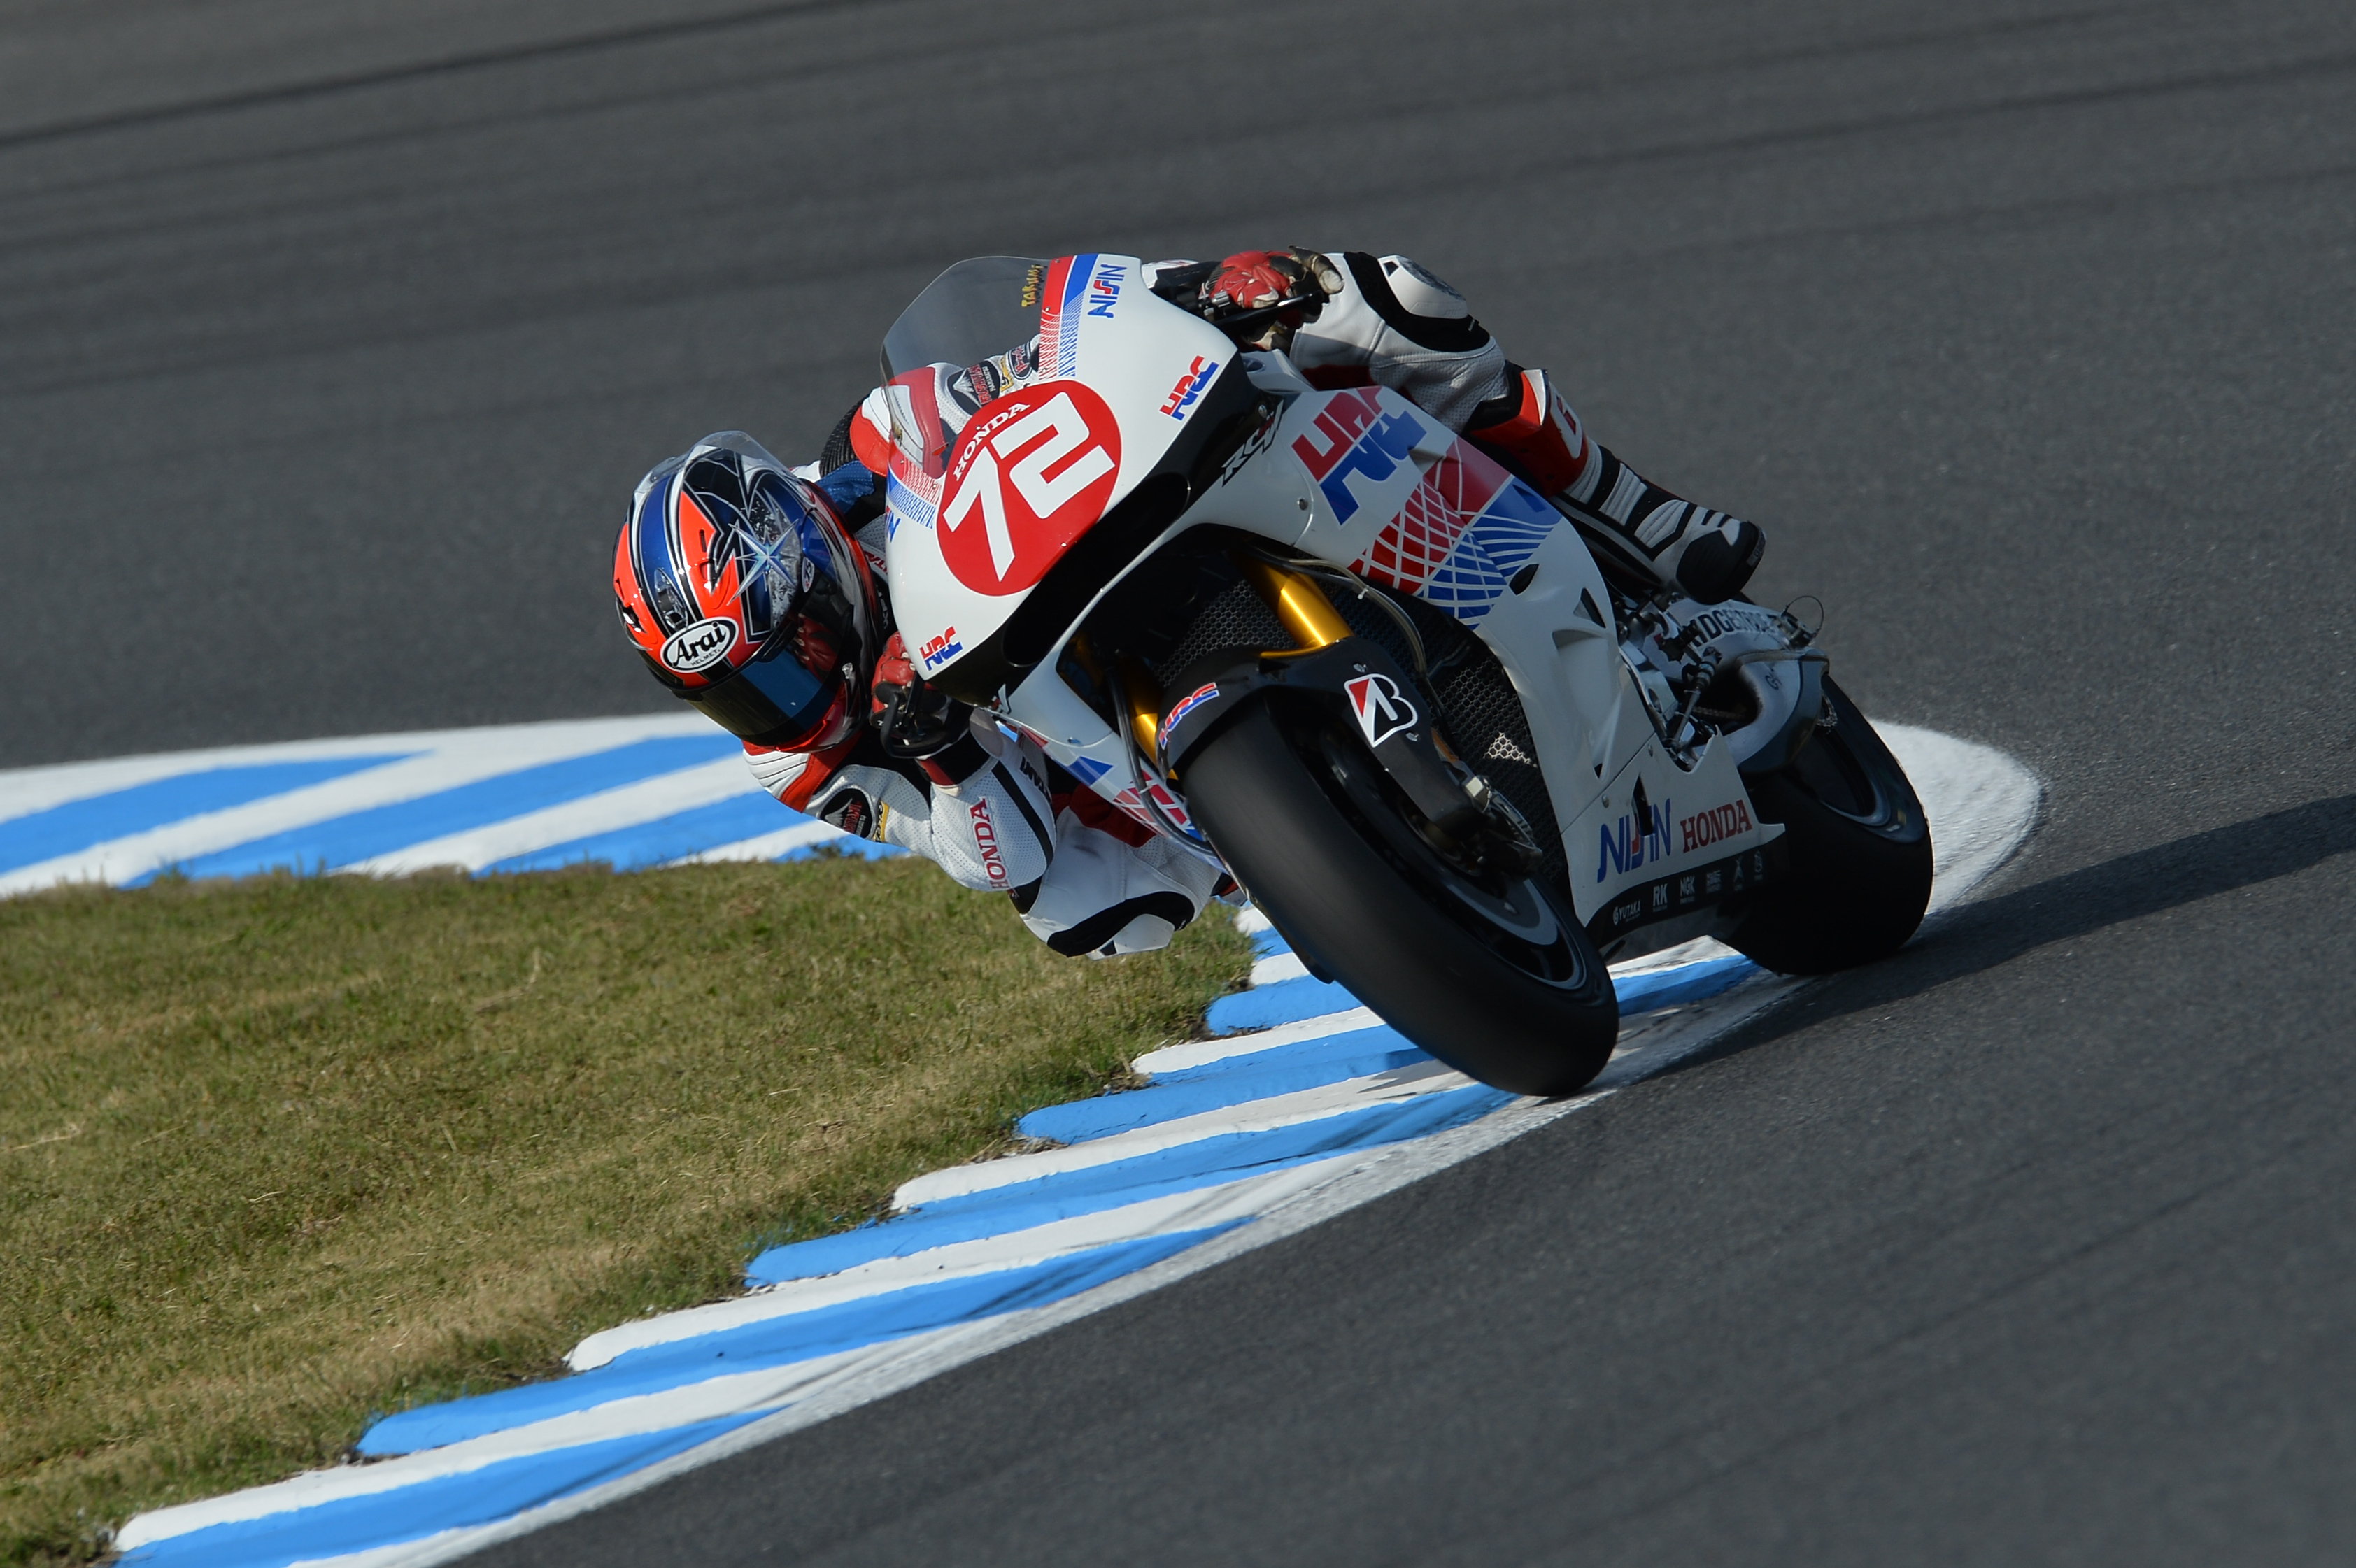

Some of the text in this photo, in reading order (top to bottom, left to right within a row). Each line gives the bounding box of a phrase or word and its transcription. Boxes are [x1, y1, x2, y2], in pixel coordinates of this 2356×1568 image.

[1159, 355, 1220, 421] HRC
[953, 402, 1030, 481] HONDA
[1291, 385, 1427, 526] HRC
[942, 392, 1115, 582] 72
[669, 622, 728, 668] Arai
[918, 625, 963, 672] HRC
[969, 797, 1009, 890] HONDA
[1680, 799, 1752, 853] HONDA
[1652, 883, 1668, 906] RK
